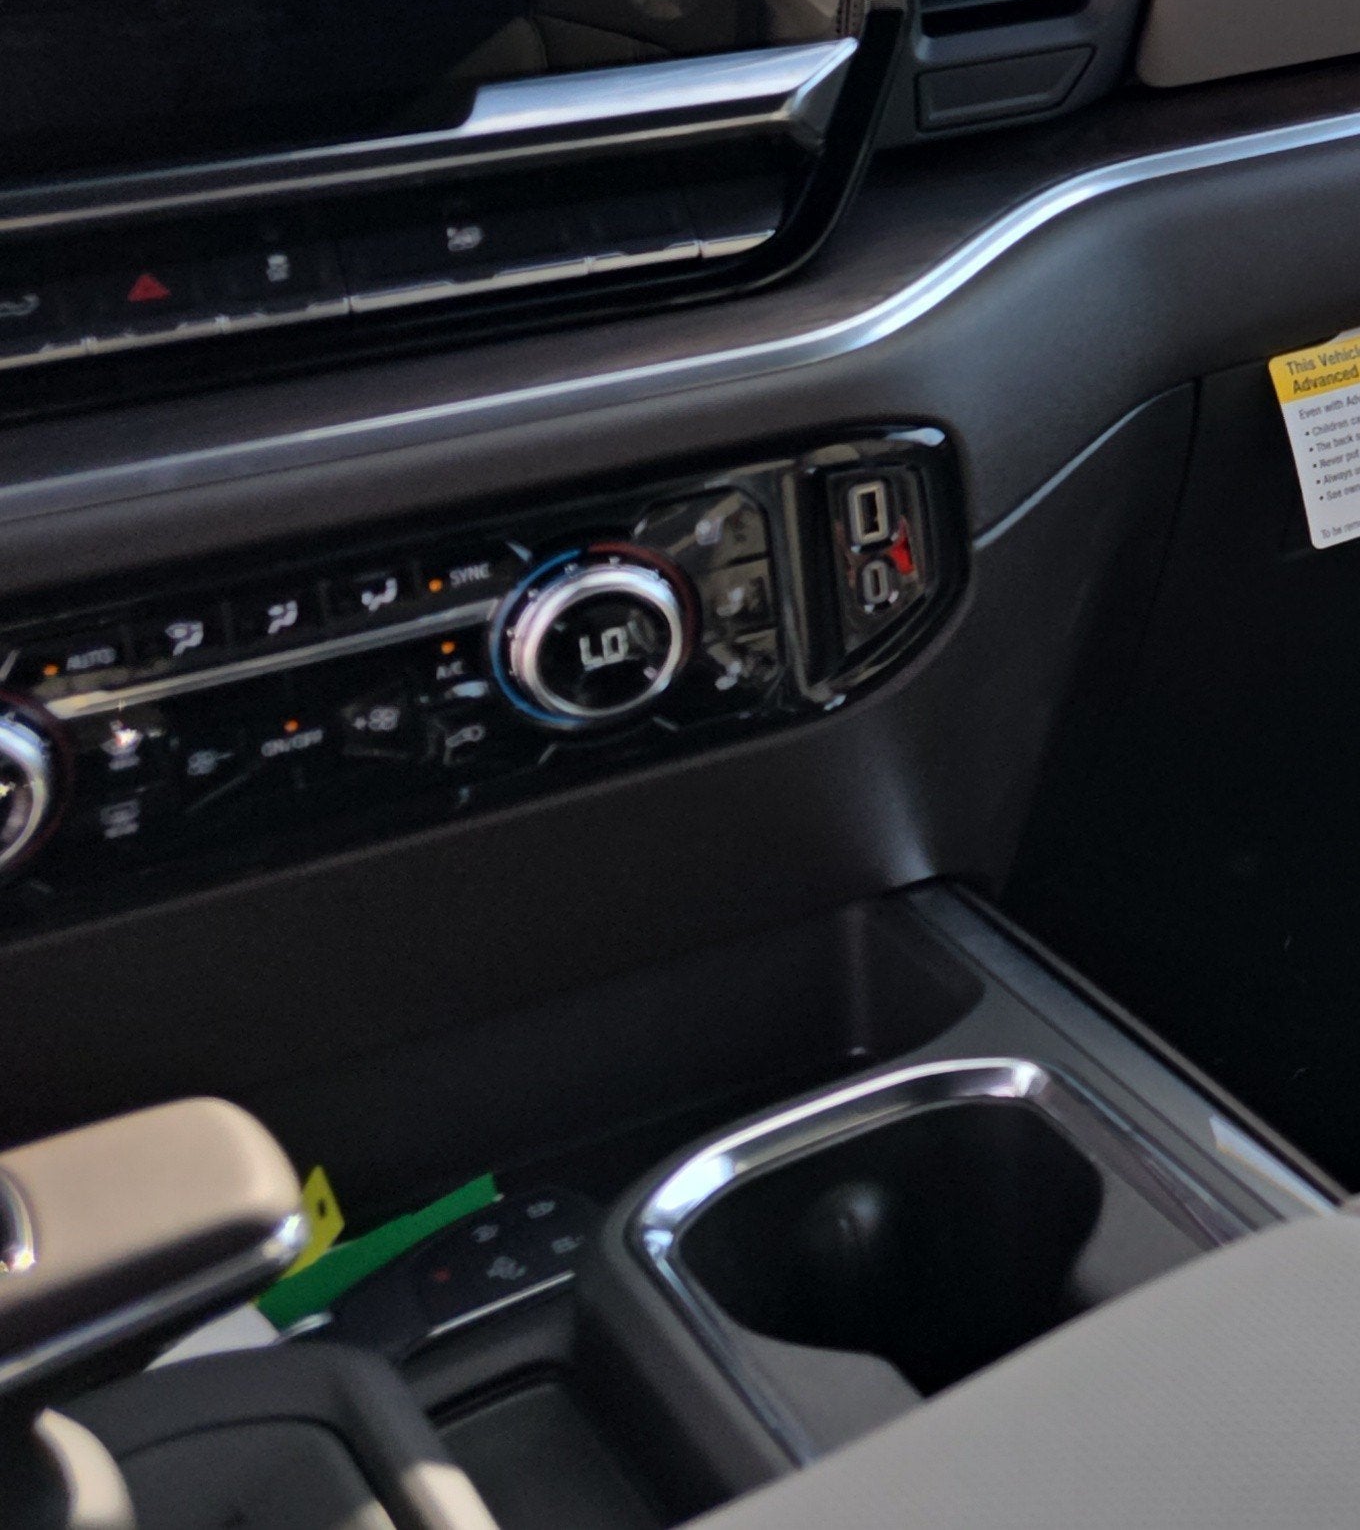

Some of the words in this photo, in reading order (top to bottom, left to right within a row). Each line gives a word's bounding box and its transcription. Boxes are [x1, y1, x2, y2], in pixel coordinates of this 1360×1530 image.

[1286, 358, 1316, 375] This
[1293, 365, 1359, 394] Advanced
[1299, 407, 1321, 420] Even
[1324, 400, 1343, 412] with
[1312, 420, 1348, 436] Children
[1316, 442, 1331, 452] The
[1333, 435, 1353, 447] back
[1345, 450, 1359, 462] put
[1324, 470, 1353, 485] Always
[1326, 490, 1341, 501] See
[1321, 529, 1331, 539] To
[1332, 526, 1342, 536] be
[449, 563, 491, 588] SYNC
